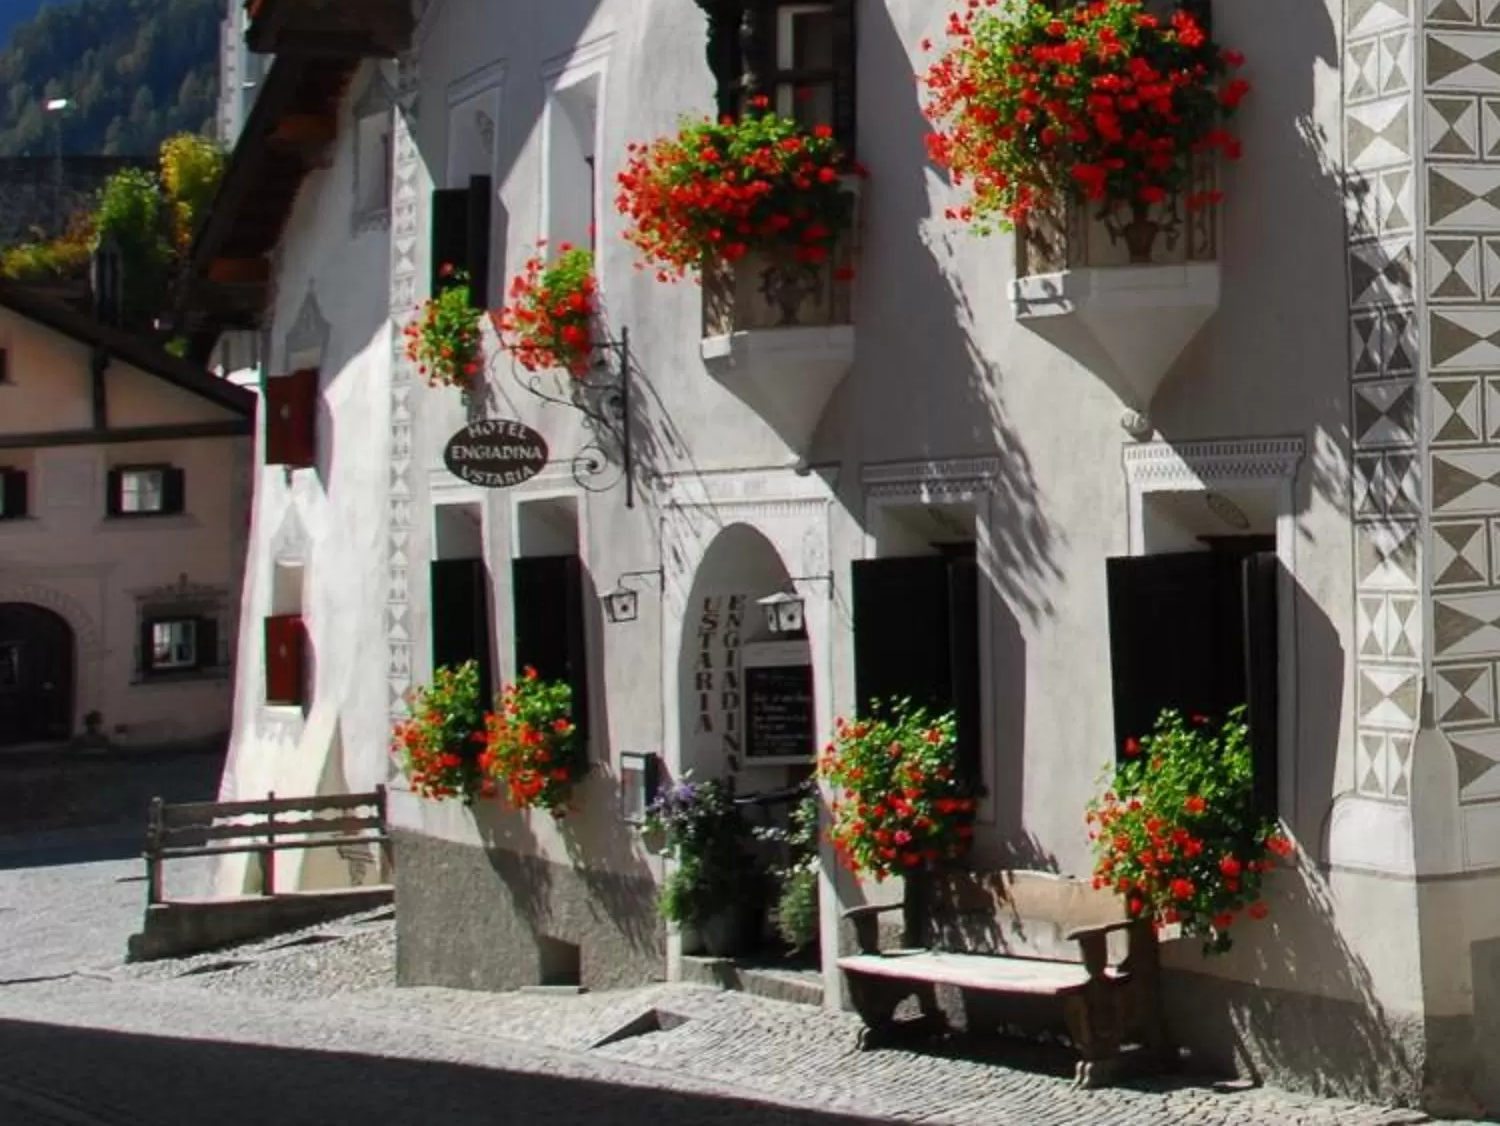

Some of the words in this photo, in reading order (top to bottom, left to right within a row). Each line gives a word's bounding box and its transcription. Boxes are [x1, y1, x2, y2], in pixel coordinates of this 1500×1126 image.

[467, 421, 526, 439] HOTEL
[451, 445, 542, 460] ENGIADINA
[694, 596, 722, 733] USTARIA
